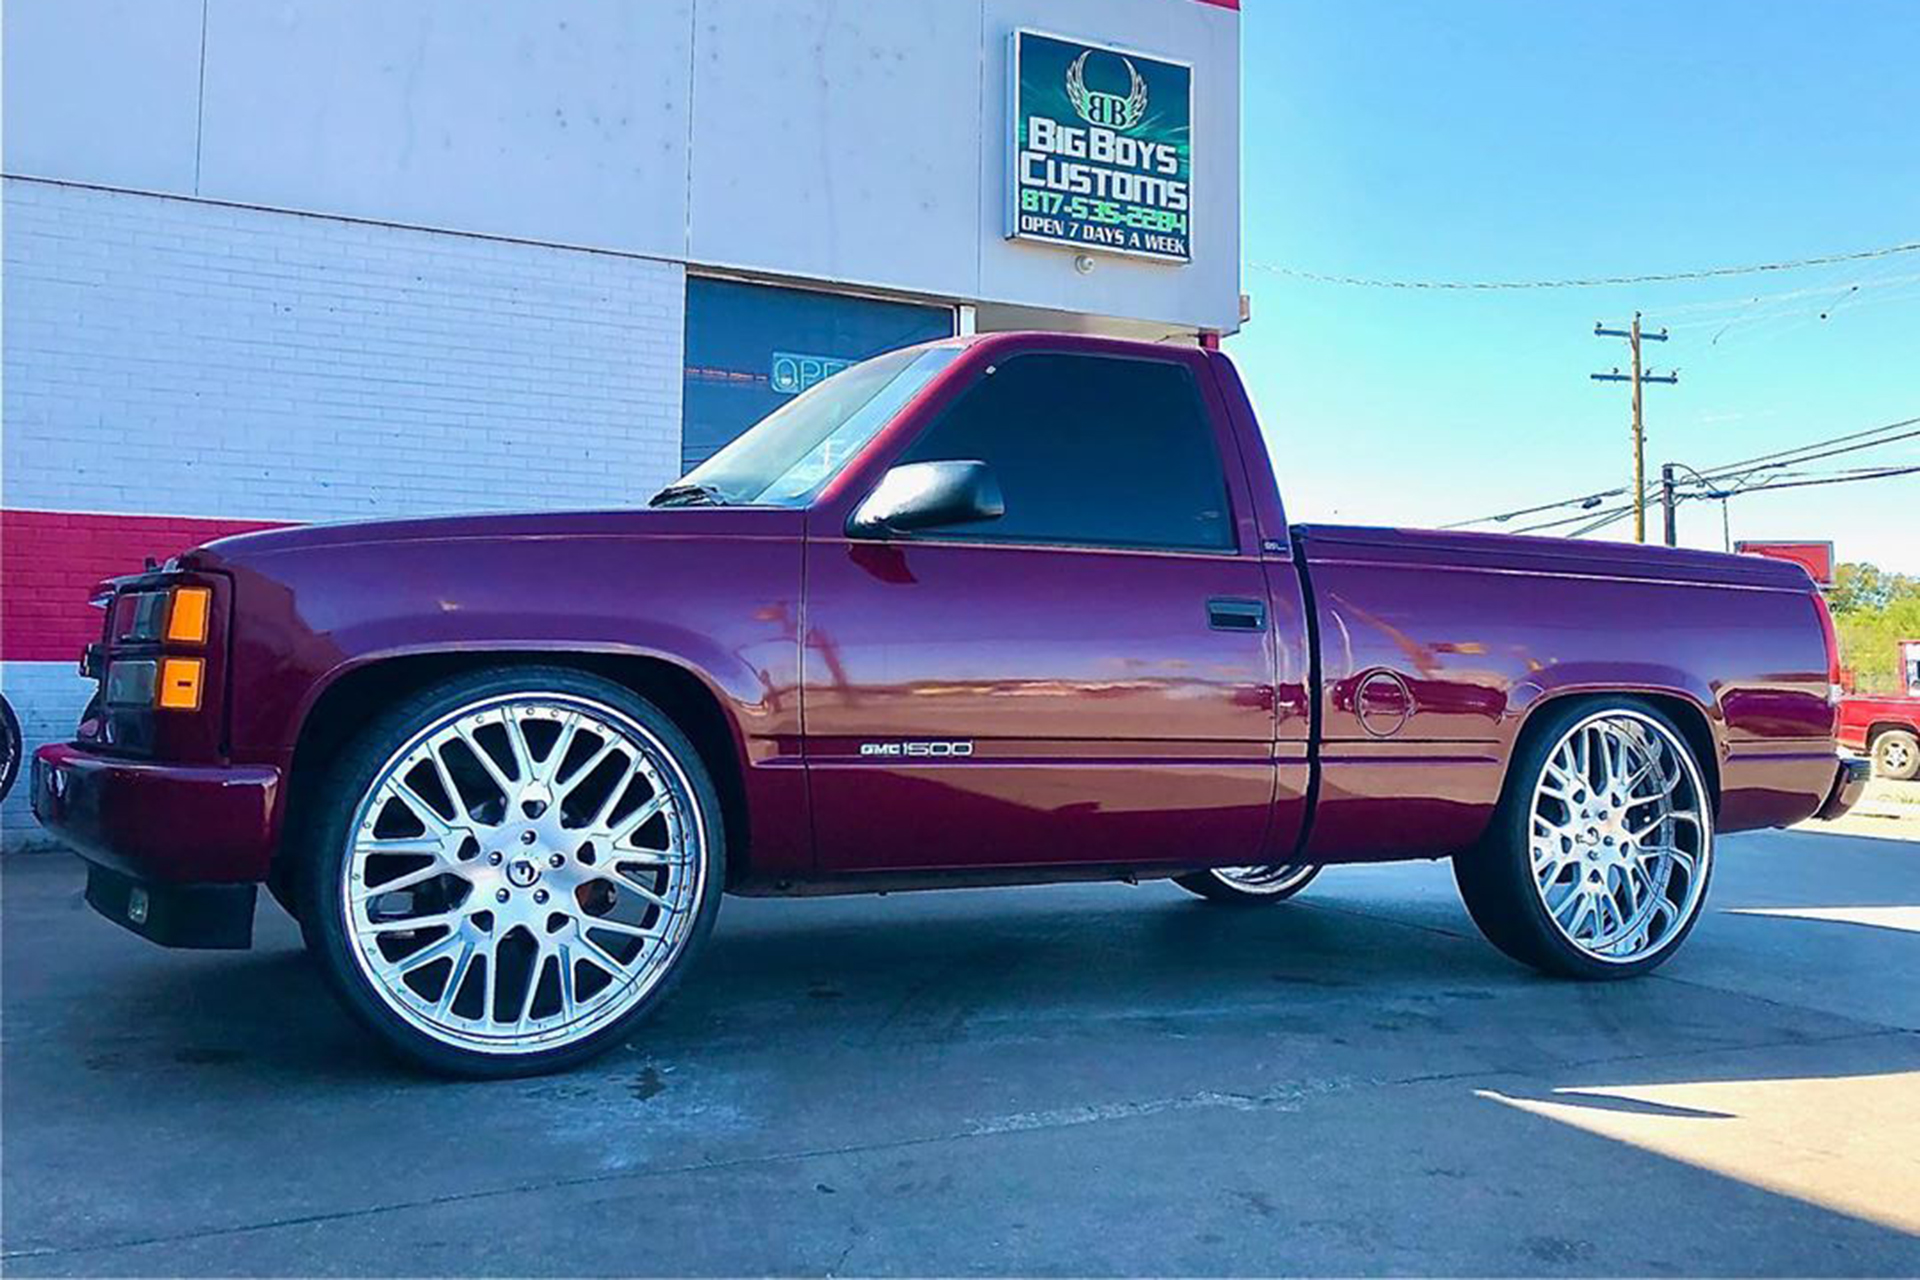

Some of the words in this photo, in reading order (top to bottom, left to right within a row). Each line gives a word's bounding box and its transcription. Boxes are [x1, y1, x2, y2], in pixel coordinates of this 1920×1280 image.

[1020, 151, 1188, 211] CUSTOMS
[1021, 188, 1187, 236] 817-535-2284
[1021, 215, 1065, 236] OPEN
[1069, 222, 1080, 238] 7
[1082, 225, 1125, 246] DAYS
[1128, 232, 1141, 248] A
[1144, 234, 1187, 255] WEEK
[774, 358, 844, 393] OP
[860, 743, 900, 755] GMC
[902, 742, 973, 756] 1500
